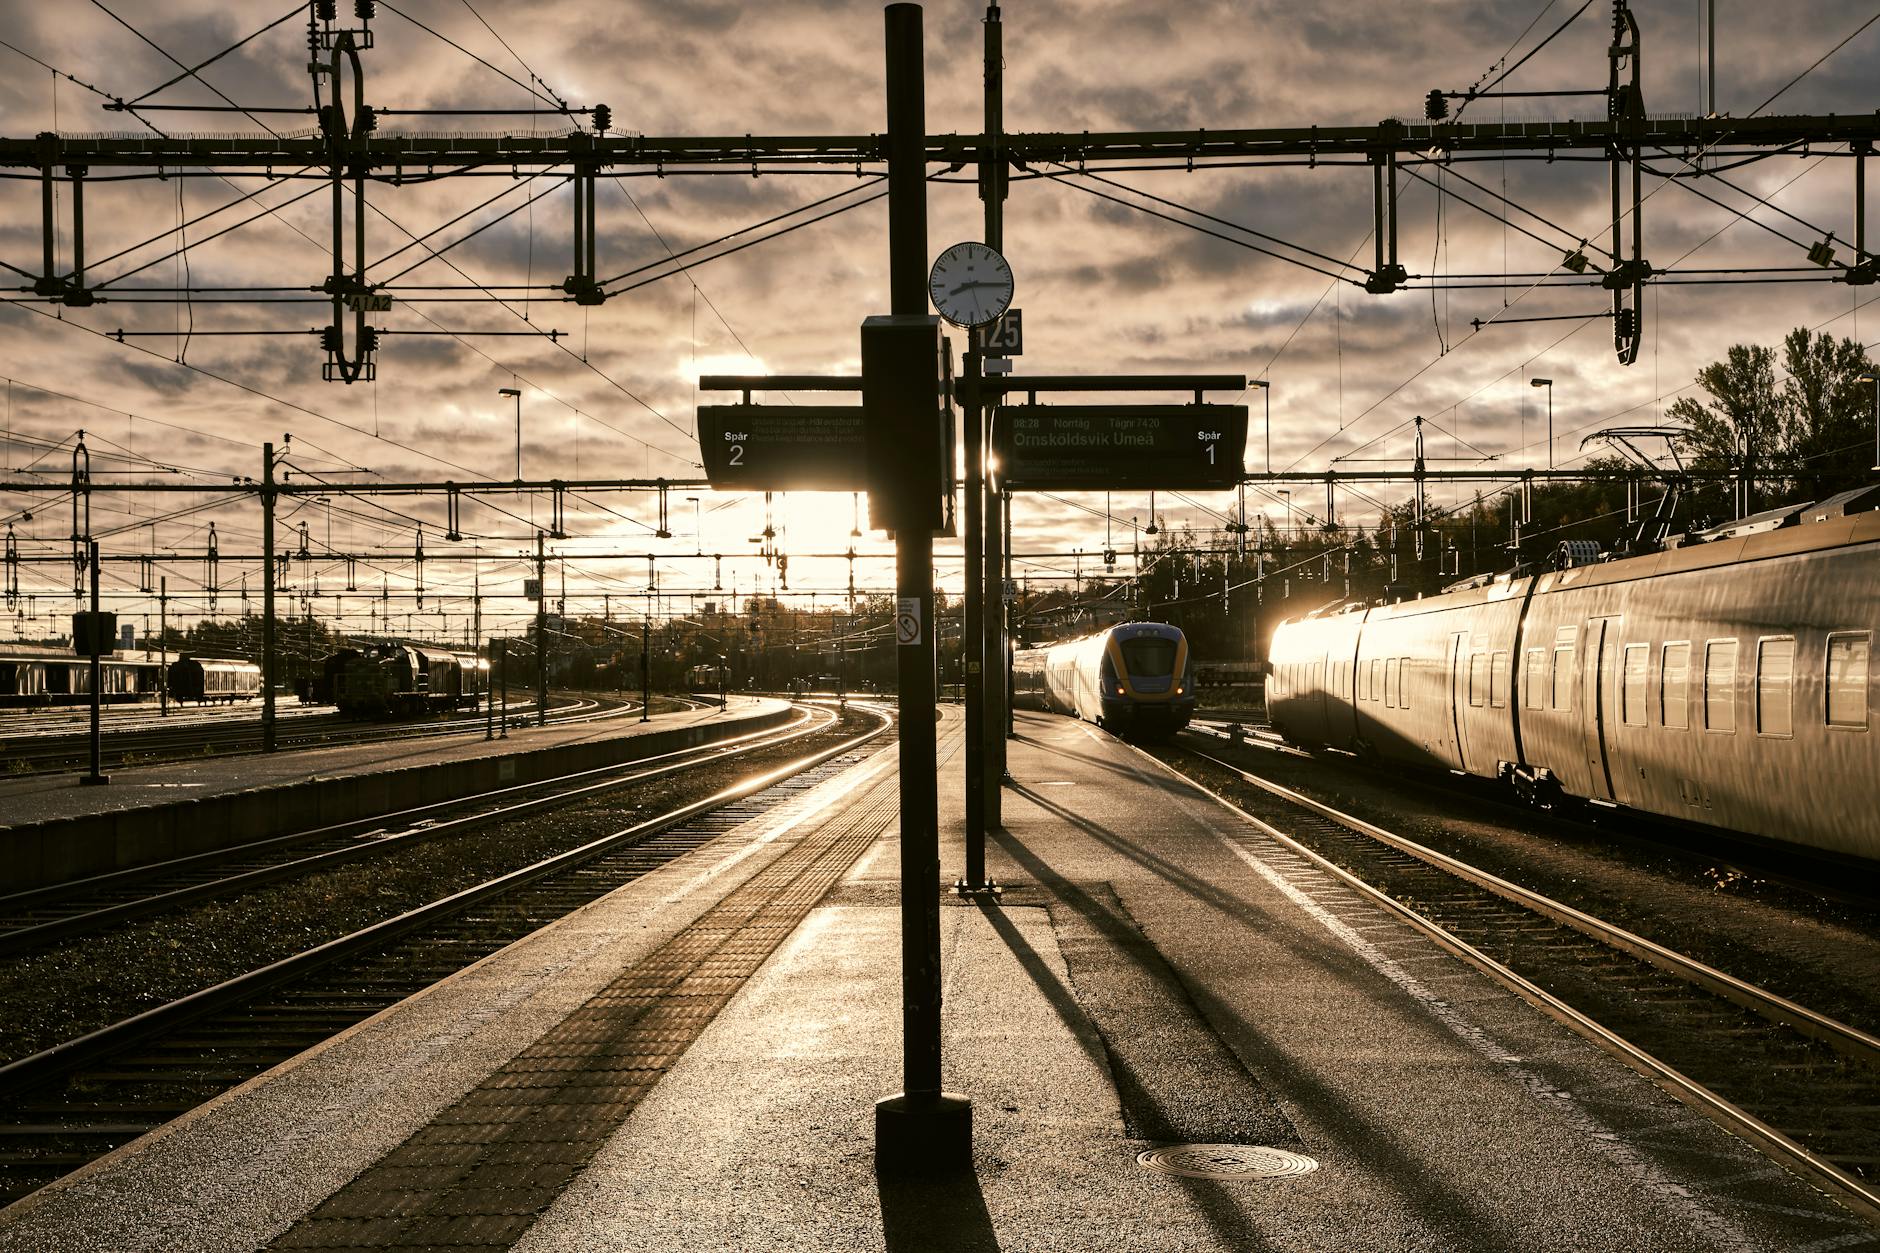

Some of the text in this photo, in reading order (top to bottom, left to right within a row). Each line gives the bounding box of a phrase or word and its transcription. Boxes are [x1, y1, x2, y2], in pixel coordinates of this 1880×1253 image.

[725, 431, 748, 443] Spår
[1113, 431, 1154, 446] Umeå
[1198, 431, 1221, 442] Spår
[729, 445, 744, 466] 2
[1206, 444, 1214, 465] 1
